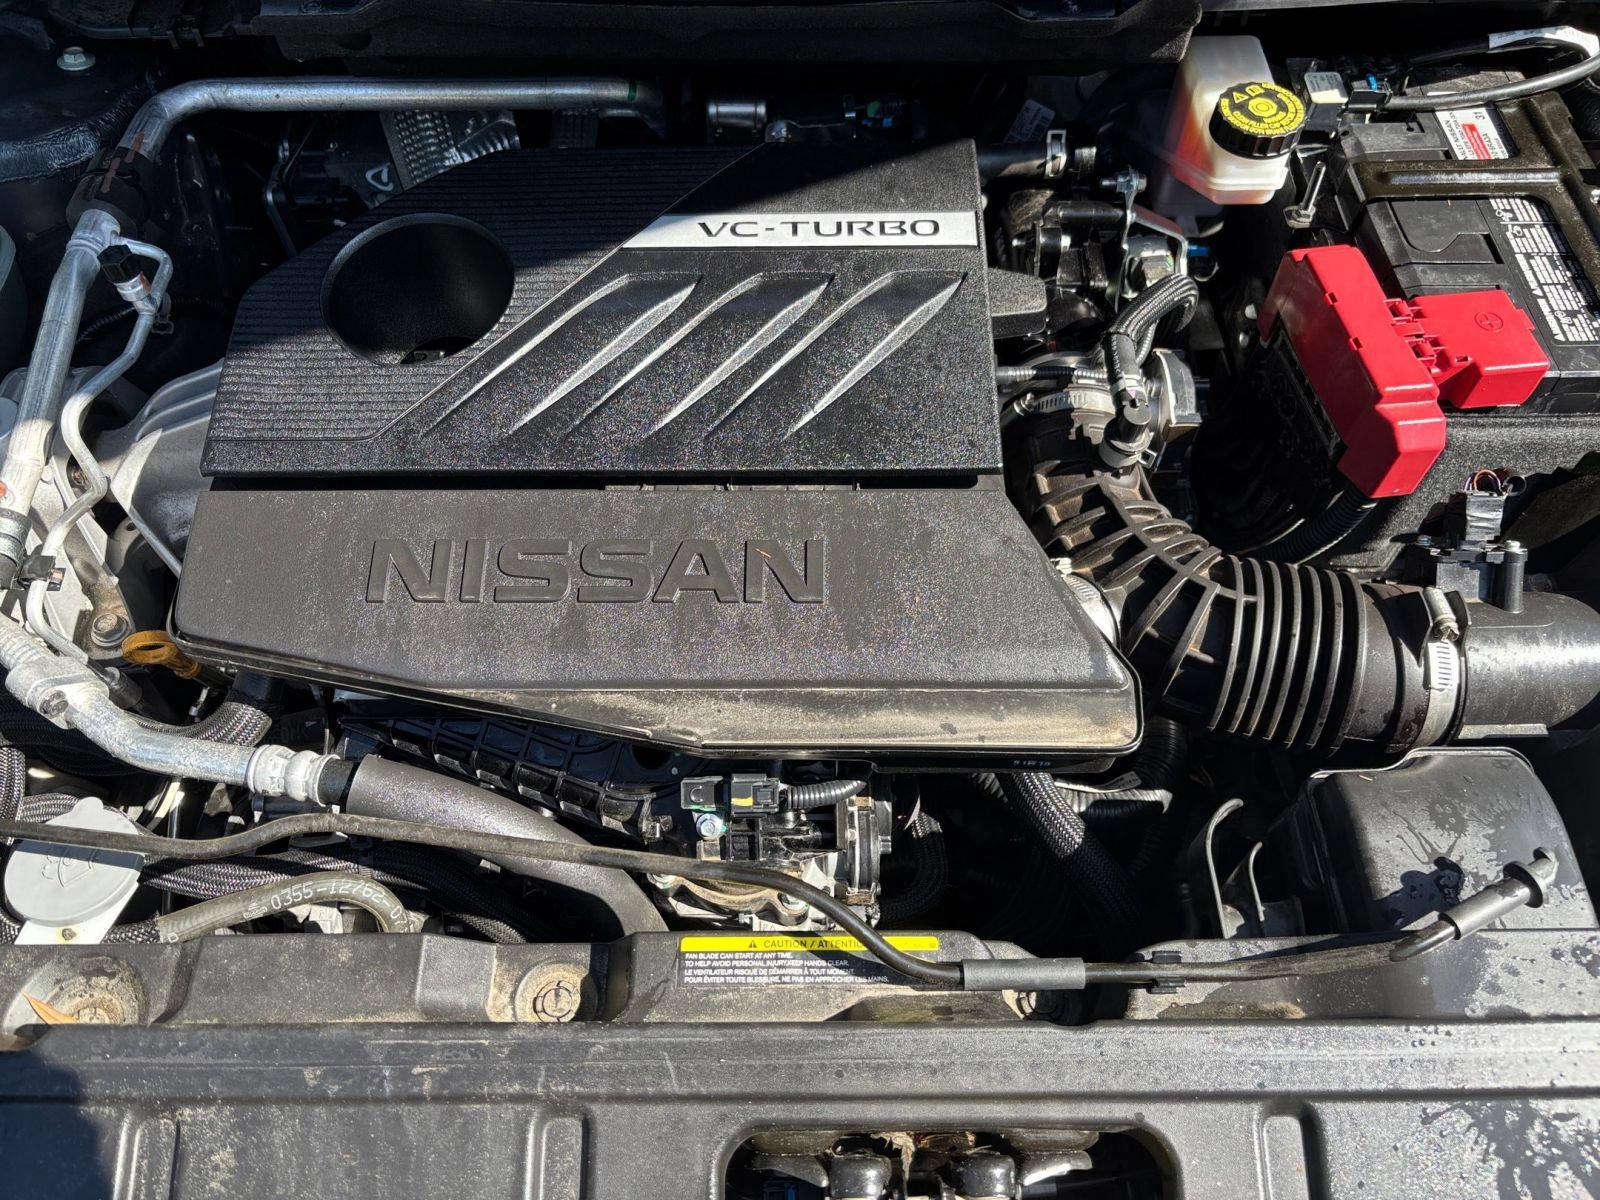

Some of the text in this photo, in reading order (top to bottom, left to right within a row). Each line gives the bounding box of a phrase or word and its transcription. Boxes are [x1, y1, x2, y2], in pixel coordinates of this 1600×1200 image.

[697, 218, 940, 238] VC-TURBO
[365, 539, 827, 603] NISSAN
[763, 940, 807, 948] CAUTION
[769, 967, 802, 975] DÉMARRER
[704, 975, 725, 983] ÉVITER
